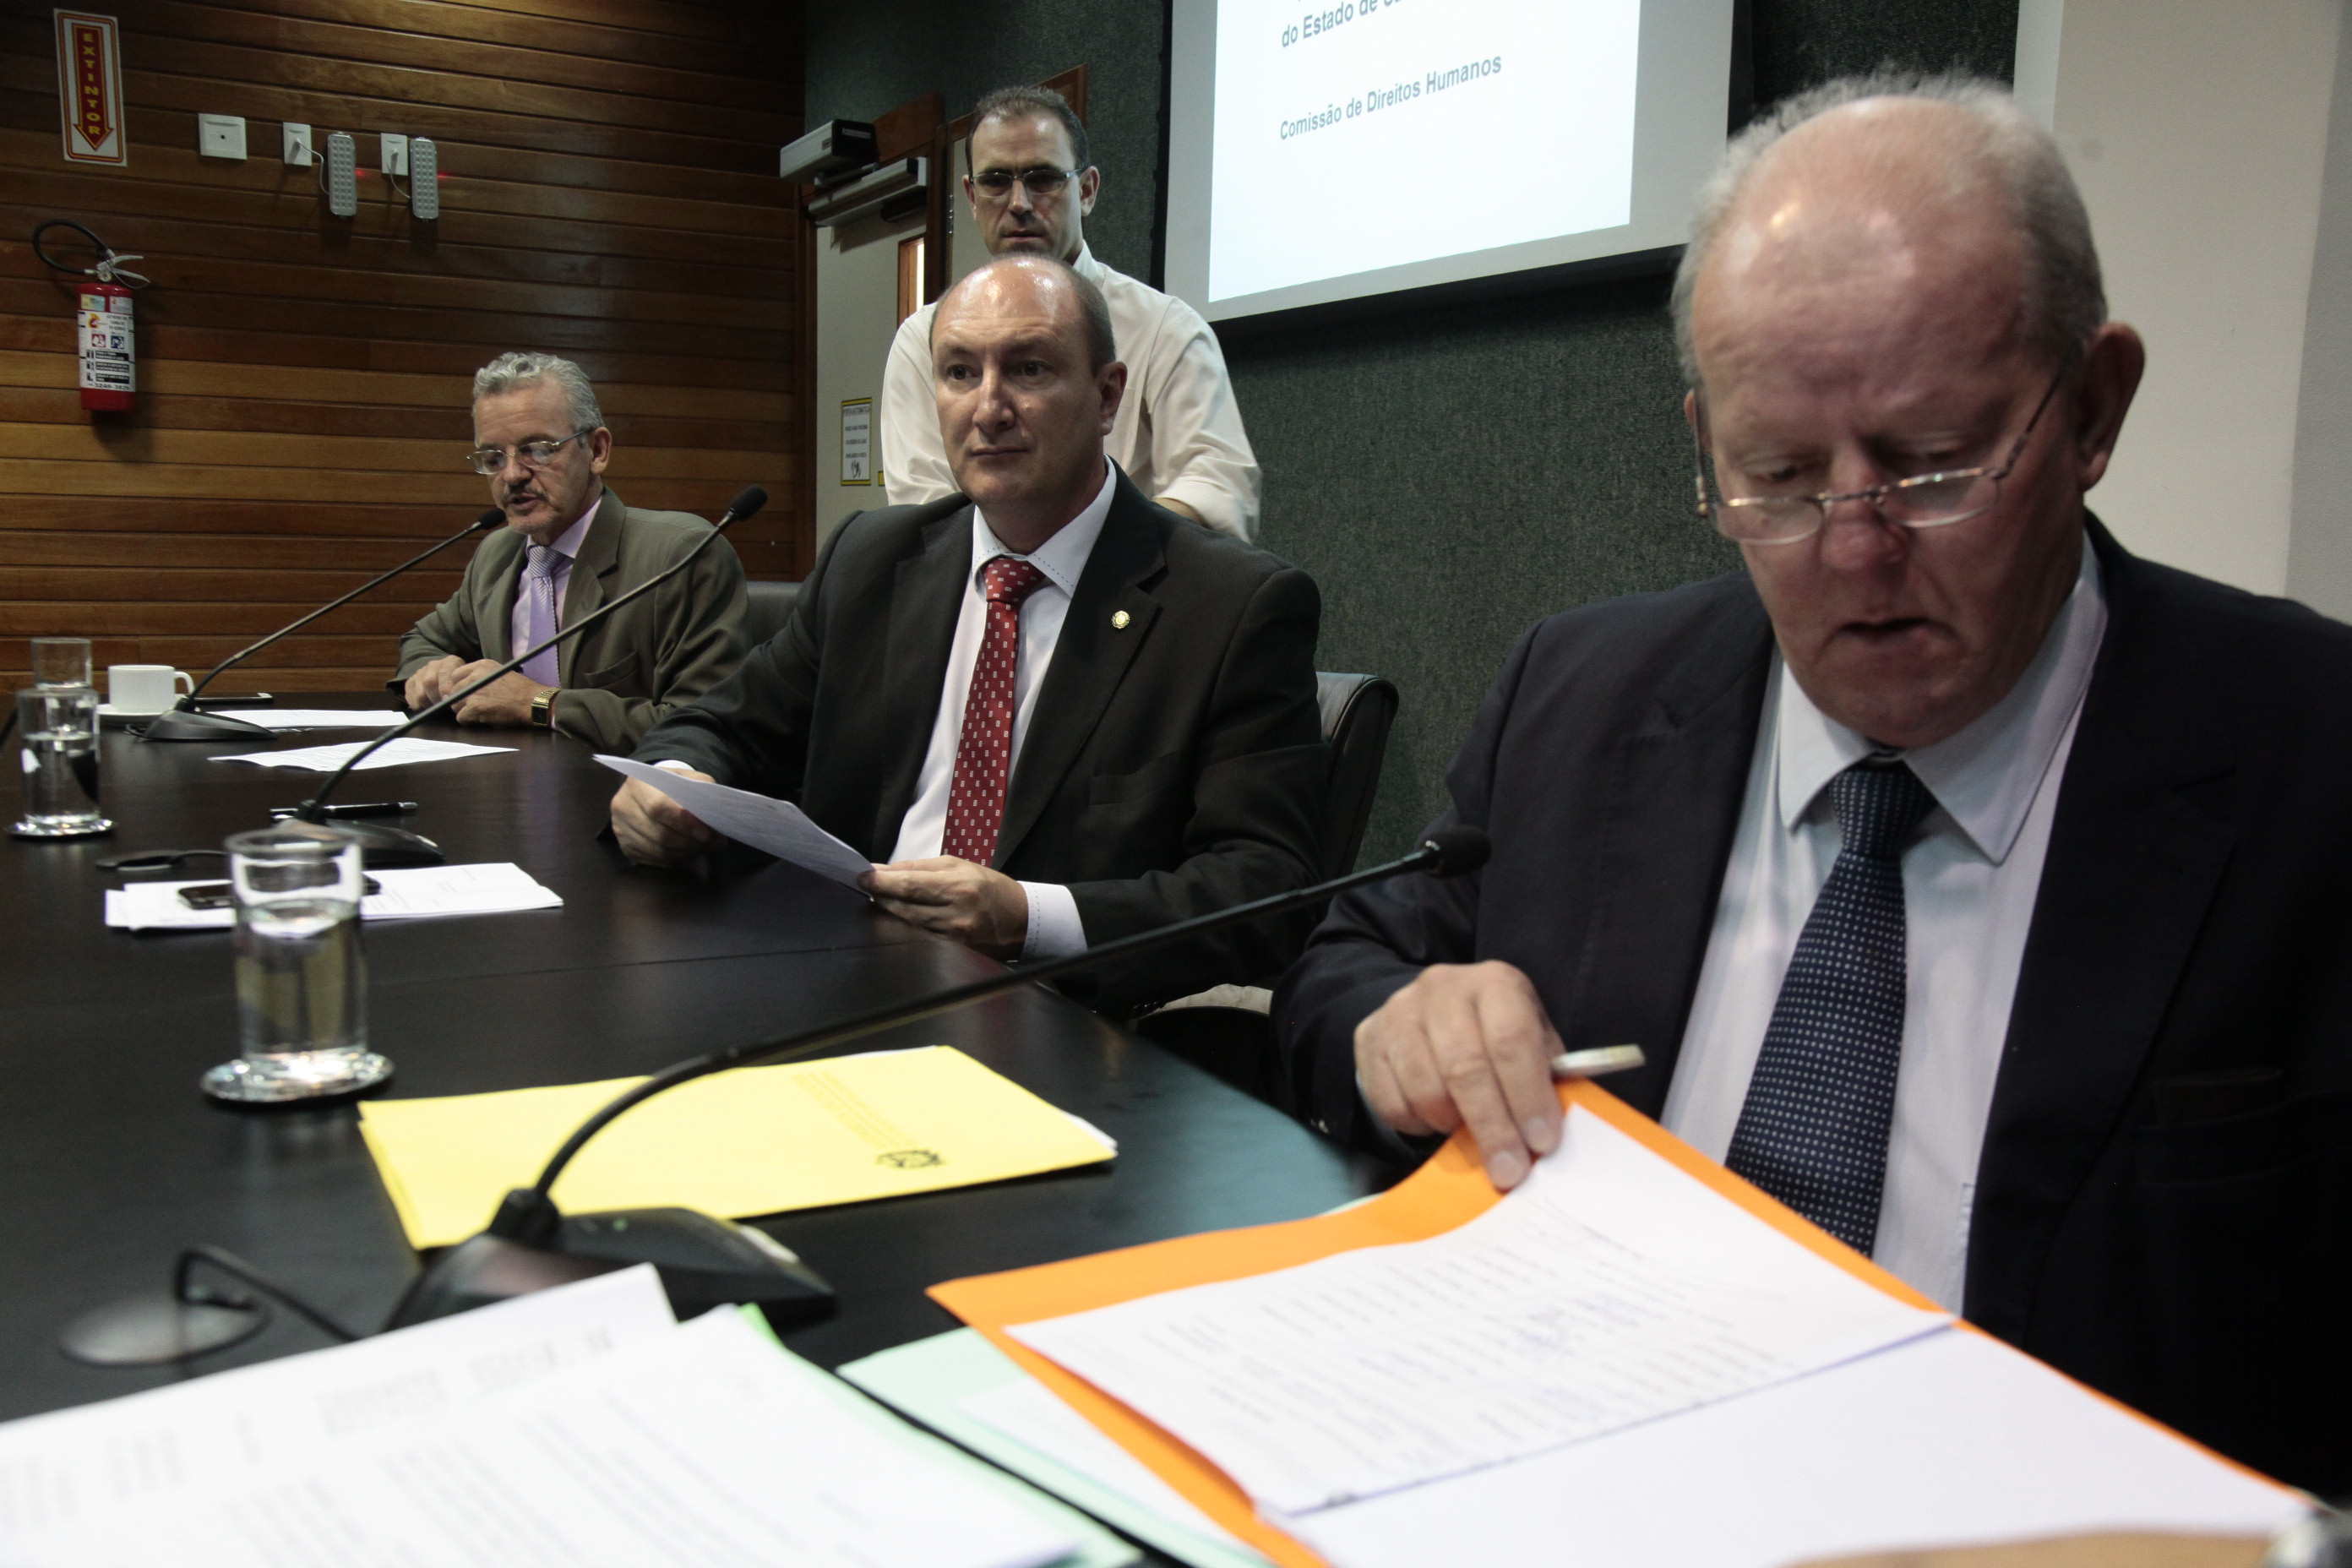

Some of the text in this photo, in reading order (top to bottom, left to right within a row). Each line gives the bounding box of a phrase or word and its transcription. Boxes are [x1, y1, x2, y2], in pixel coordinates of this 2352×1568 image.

[1282, 0, 1378, 48] do Estado de
[83, 33, 101, 135] EXTINTOR
[1280, 55, 1503, 141] Comissão de Direitos Humanos
